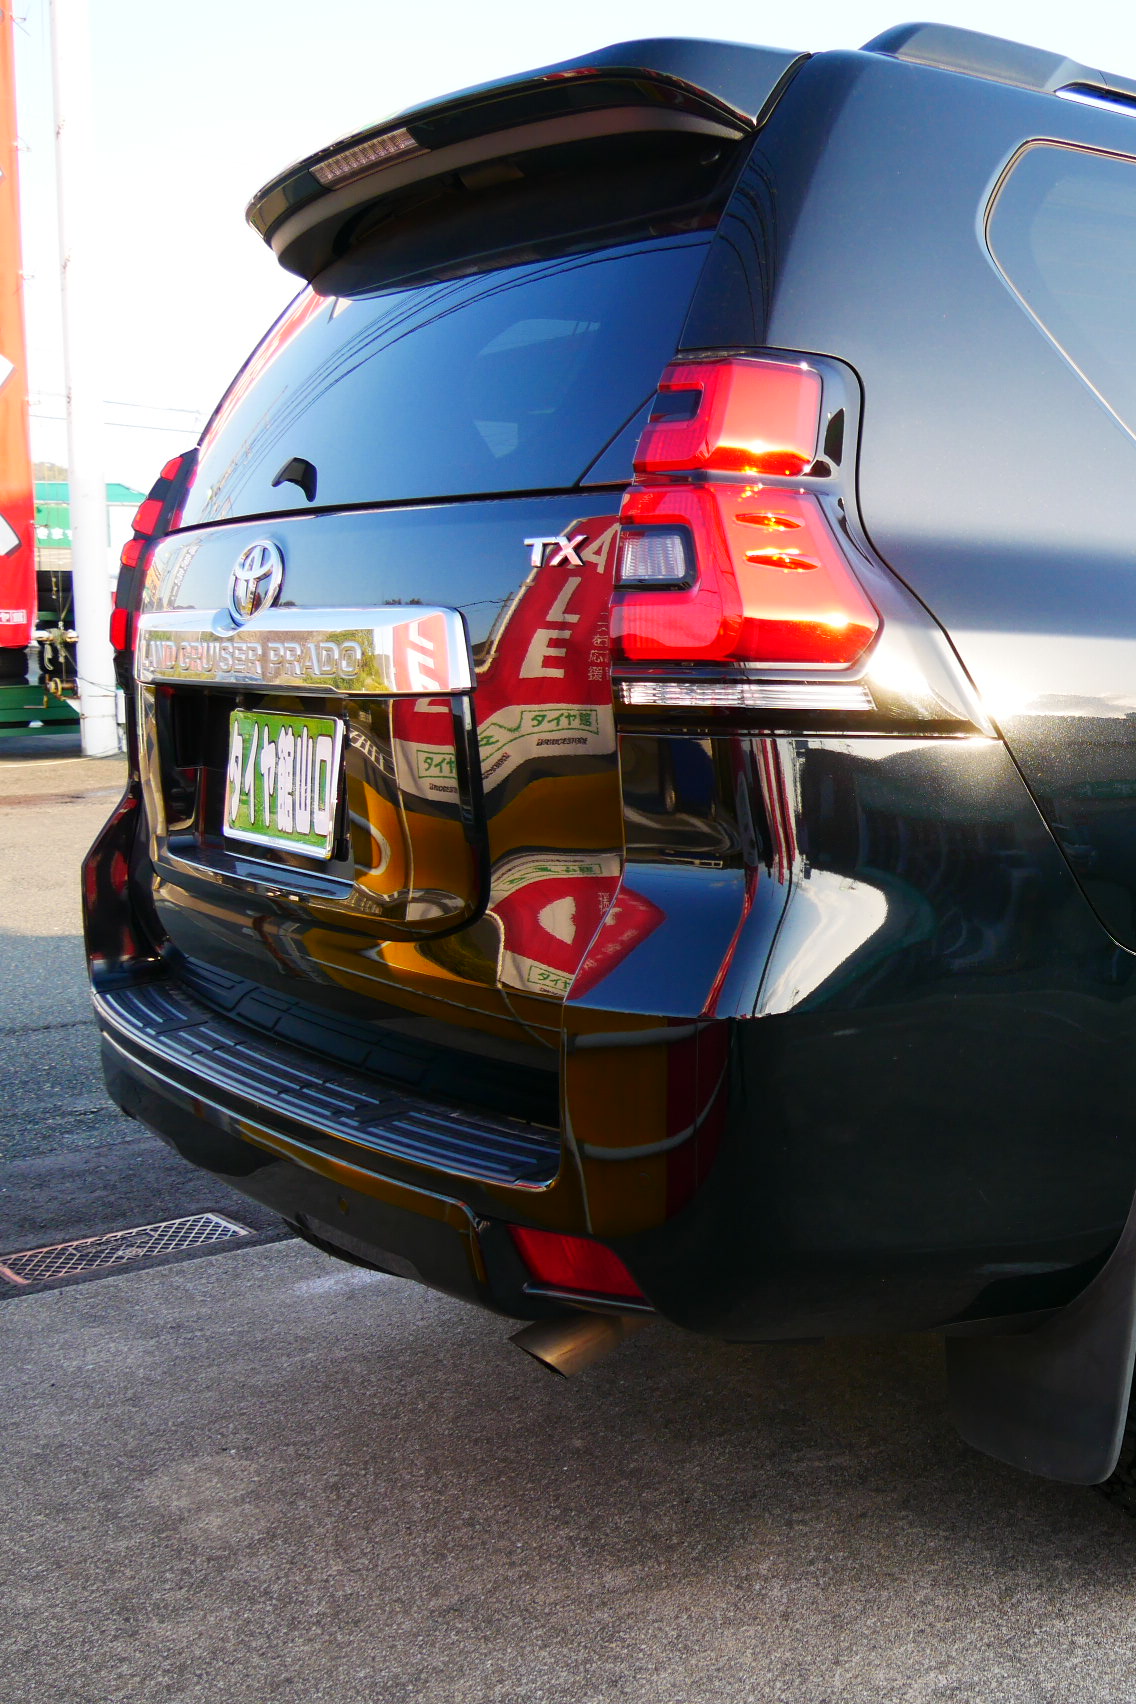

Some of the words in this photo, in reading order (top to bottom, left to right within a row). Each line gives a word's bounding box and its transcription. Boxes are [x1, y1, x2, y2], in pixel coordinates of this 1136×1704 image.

[523, 535, 588, 568] TX
[180, 640, 262, 675] CRUISER
[267, 641, 363, 679] PRADO
